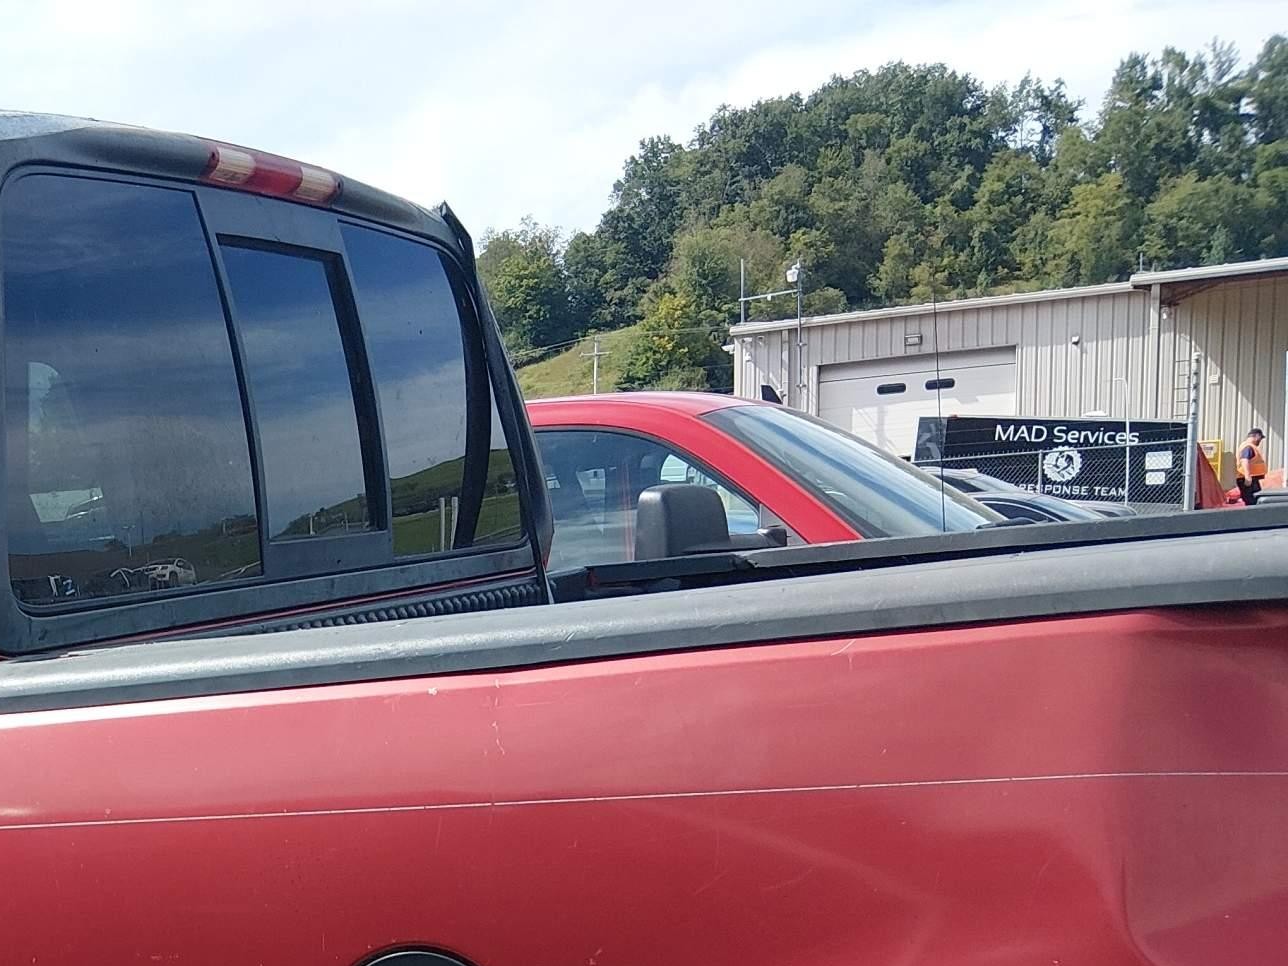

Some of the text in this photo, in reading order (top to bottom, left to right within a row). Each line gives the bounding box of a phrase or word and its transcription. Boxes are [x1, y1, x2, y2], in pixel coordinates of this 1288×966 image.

[994, 424, 1140, 444] MAD Services
[1093, 486, 1127, 497] TEAM
